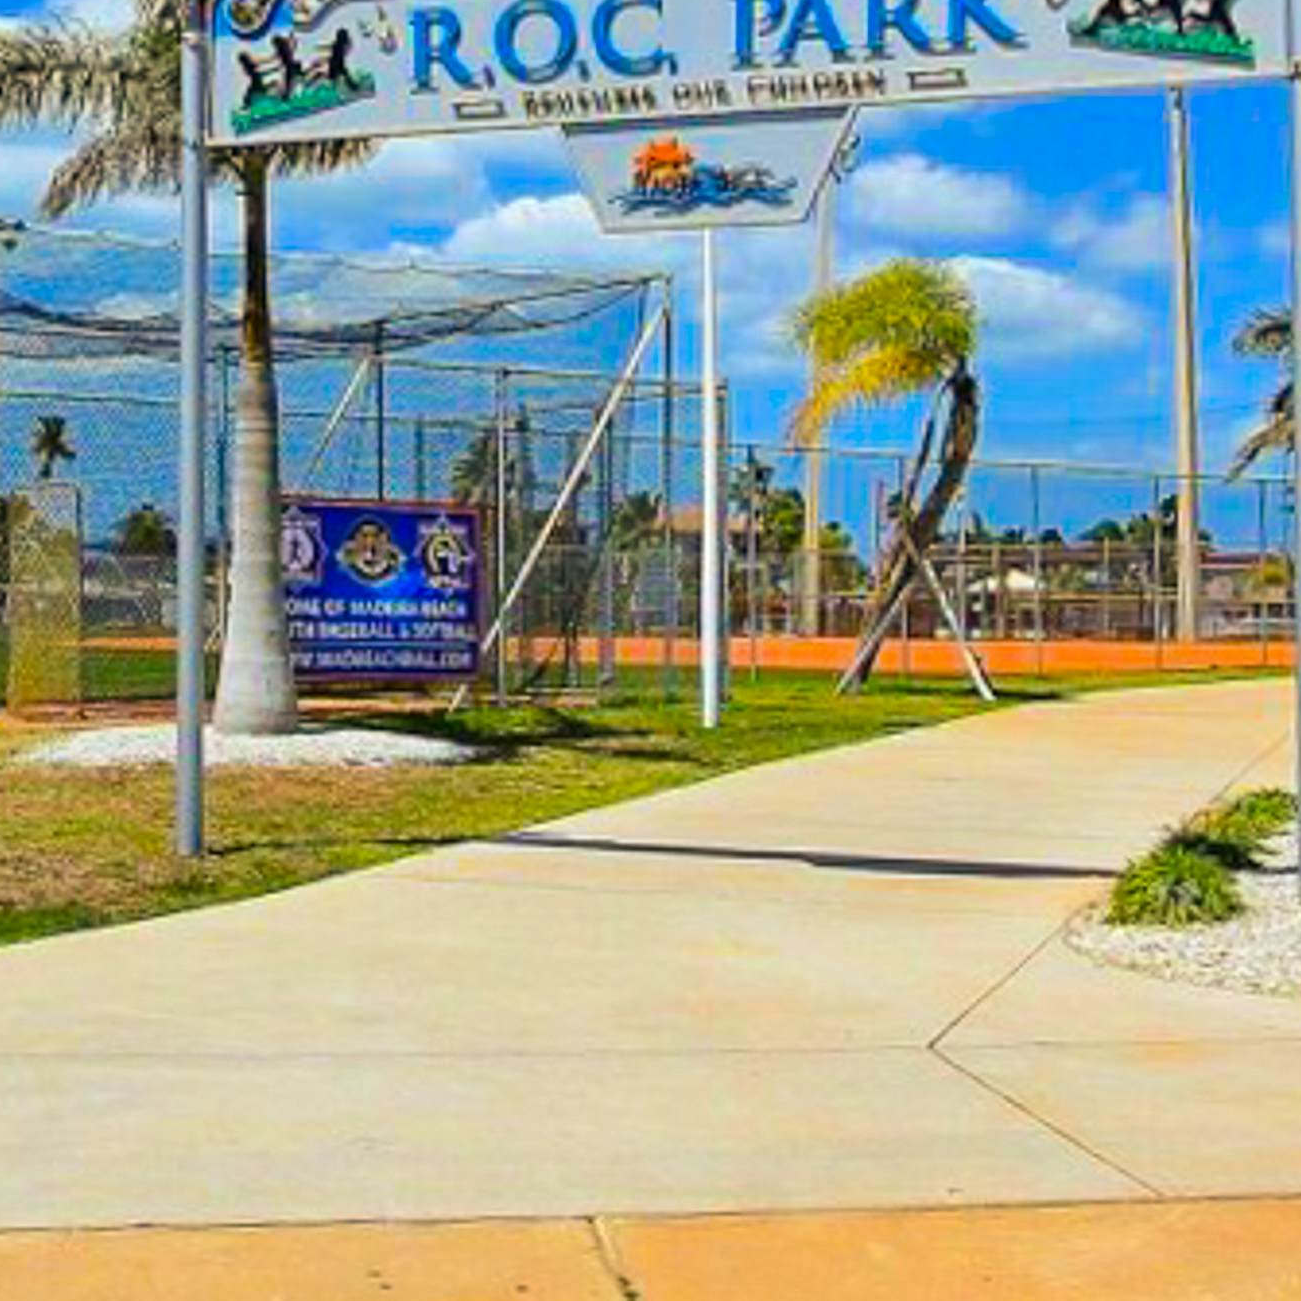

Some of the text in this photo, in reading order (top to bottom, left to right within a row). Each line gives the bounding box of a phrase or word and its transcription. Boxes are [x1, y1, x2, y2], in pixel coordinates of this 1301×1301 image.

[285, 598, 321, 616] OME
[324, 599, 344, 616] OF
[421, 599, 467, 617] BEACH
[318, 621, 395, 639] BASEBALL
[413, 622, 477, 641] SOFTBALL
